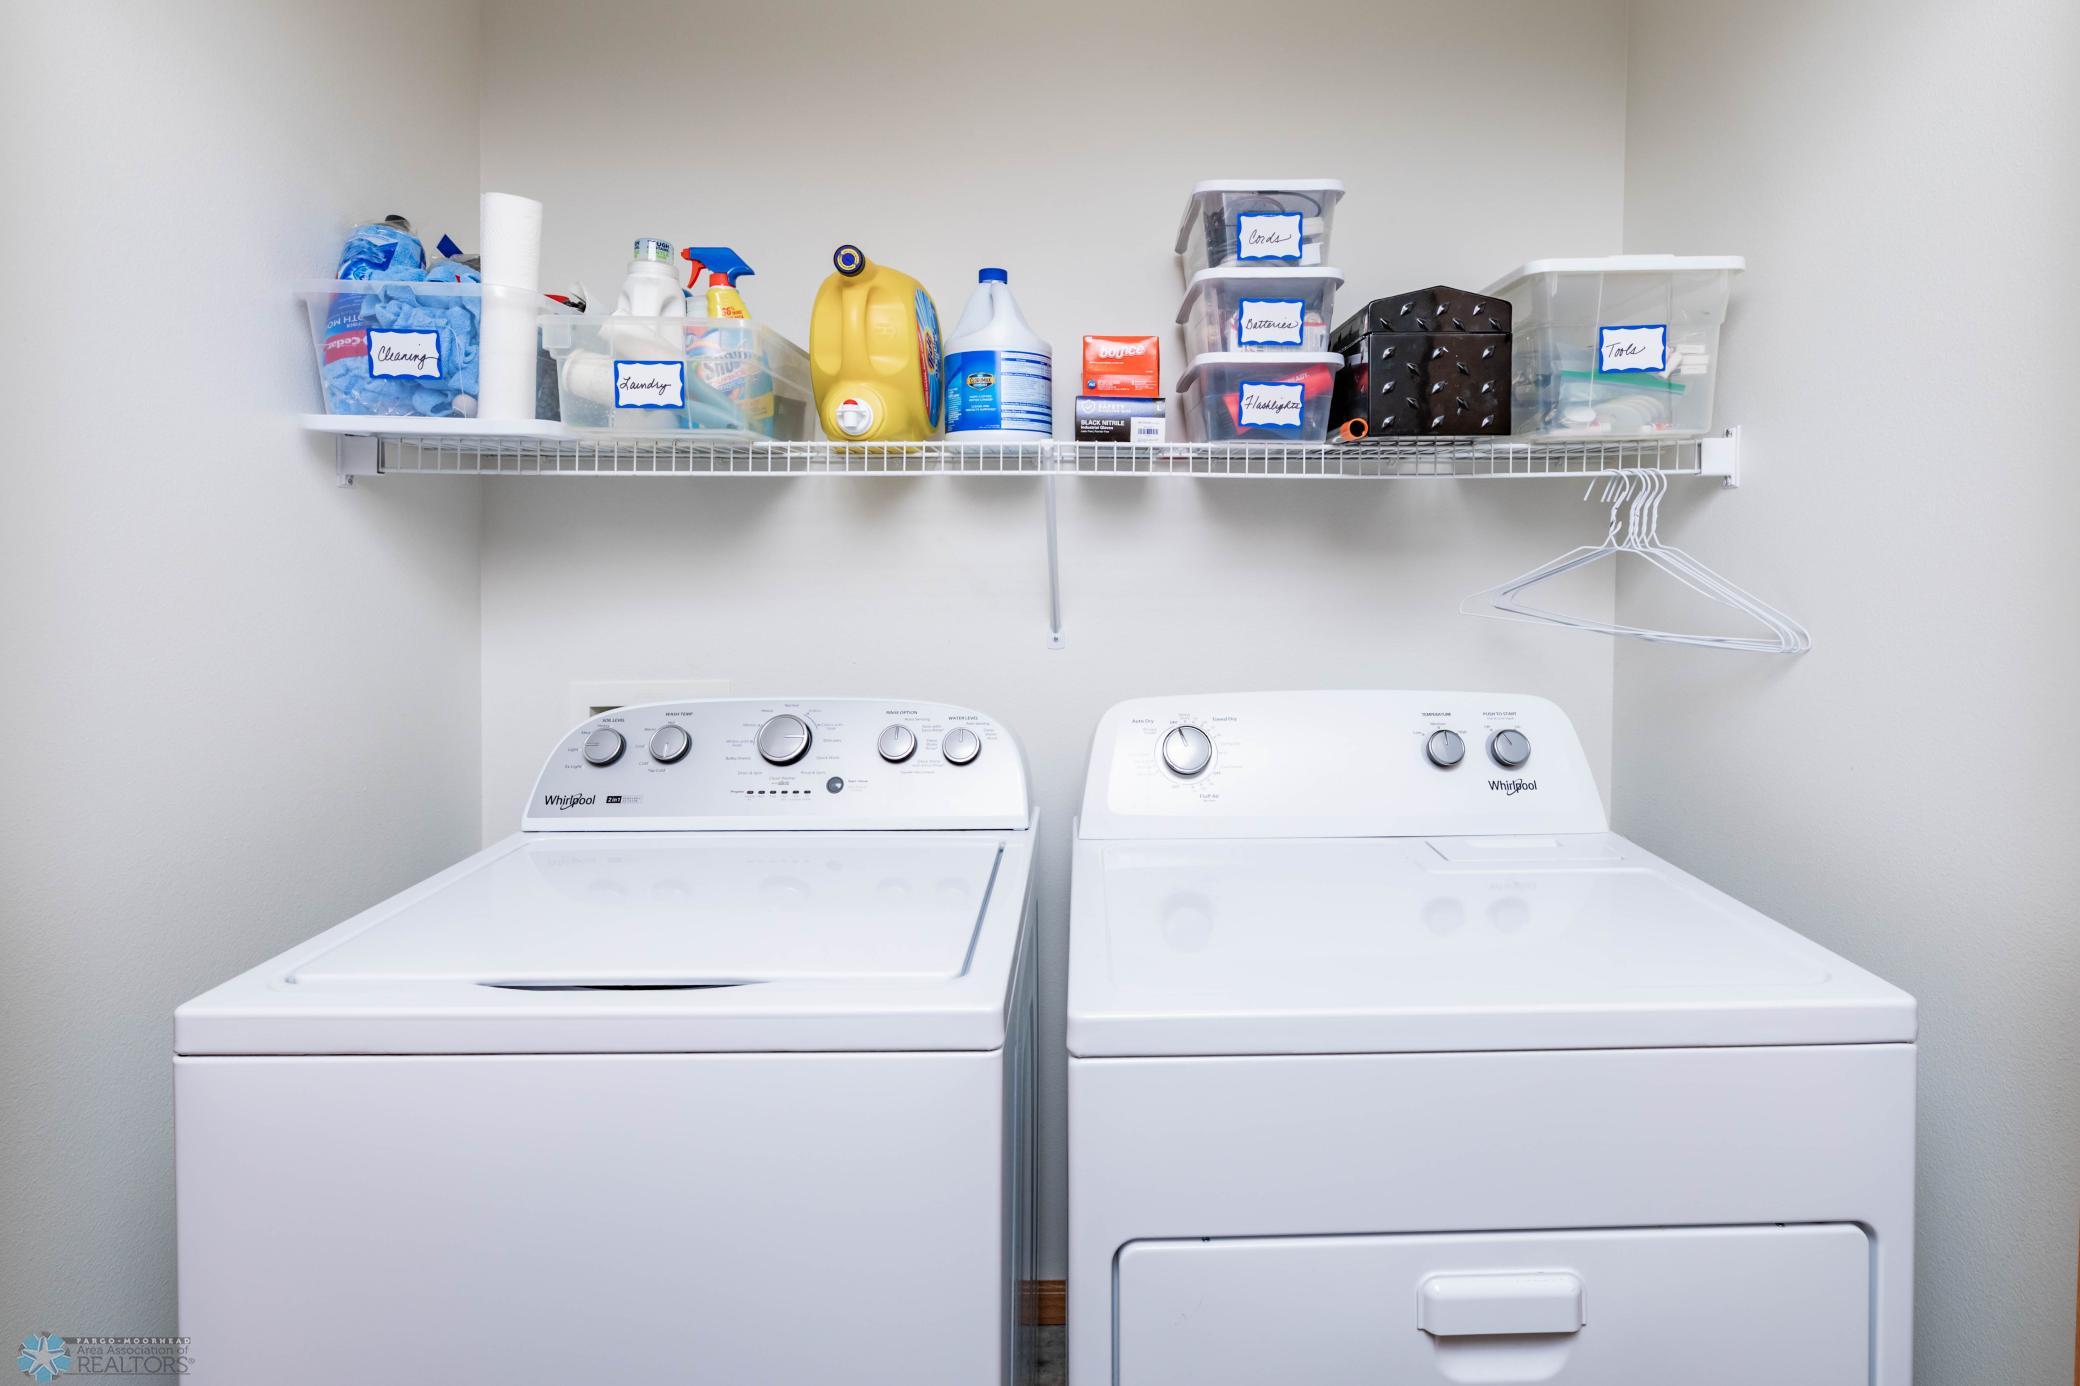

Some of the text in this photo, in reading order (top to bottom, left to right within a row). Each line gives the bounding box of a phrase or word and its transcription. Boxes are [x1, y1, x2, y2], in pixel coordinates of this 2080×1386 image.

[1248, 228, 1291, 245] Cords
[1246, 317, 1299, 329] Batteries
[378, 344, 440, 370] Cleaning
[1606, 342, 1646, 358] Tools
[619, 376, 672, 395] Laundry
[1245, 396, 1301, 414] Flashlights
[1487, 778, 1537, 796] Whirlpool
[545, 793, 596, 810] Whirlpool
